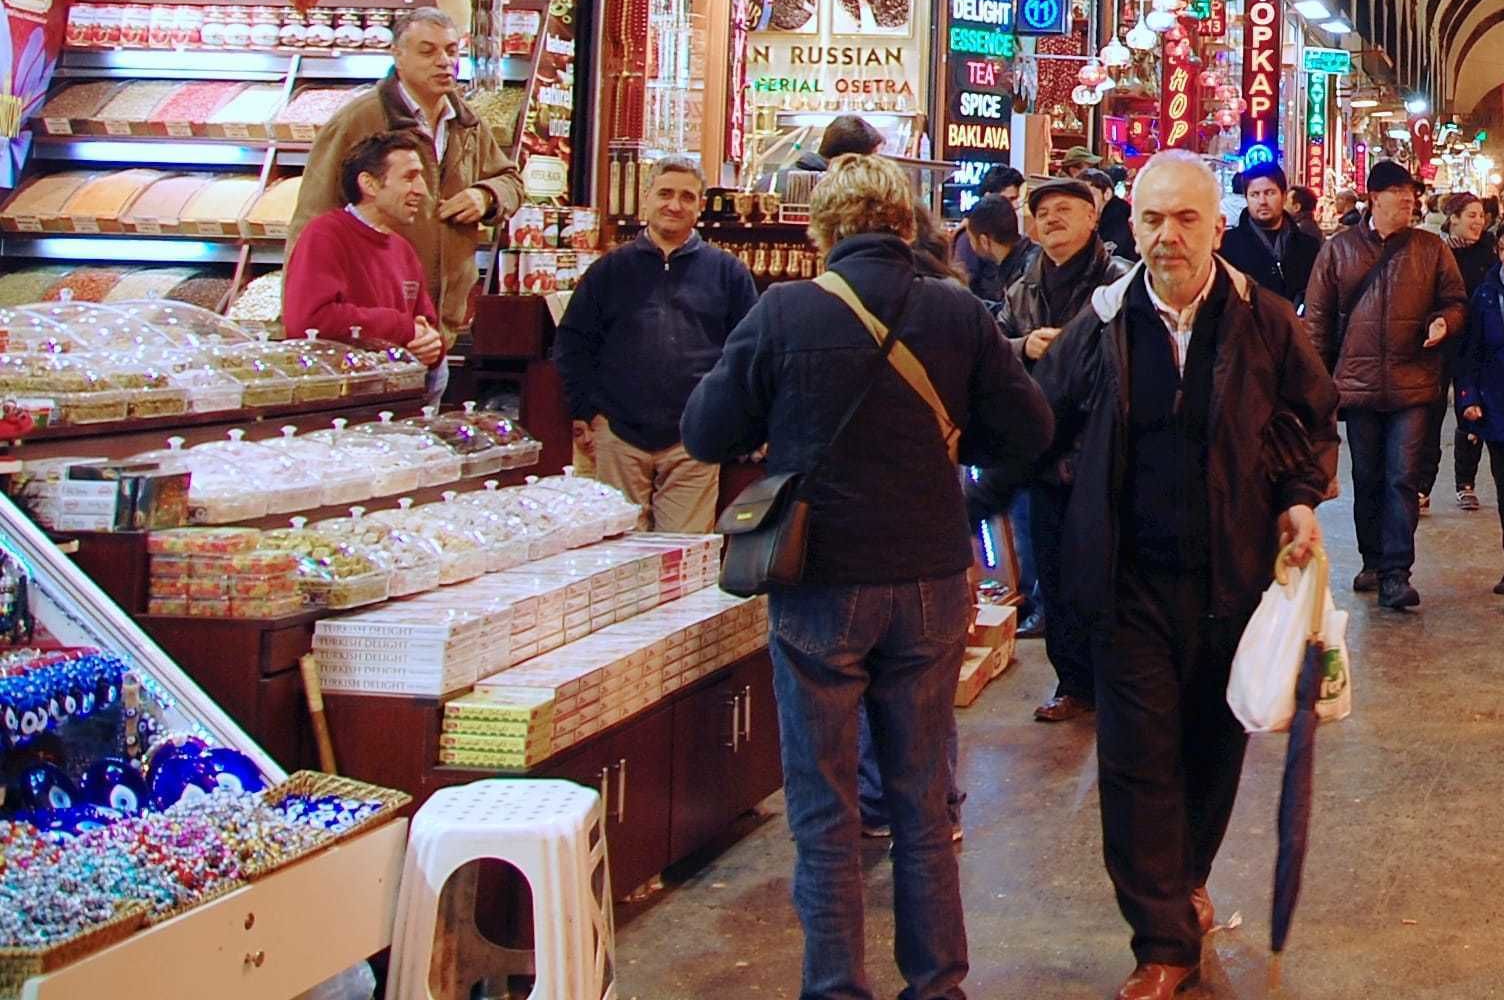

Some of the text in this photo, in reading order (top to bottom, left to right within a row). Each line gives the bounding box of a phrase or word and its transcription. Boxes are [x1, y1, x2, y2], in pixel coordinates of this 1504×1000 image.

[951, 27, 1015, 57] ESSENCE
[790, 45, 904, 67] RUSSIAN
[967, 61, 995, 86] TEA
[835, 77, 913, 97] OSETRA
[1166, 54, 1188, 146] HOP
[960, 92, 1002, 118] SPICE
[948, 123, 1010, 150] BAKLAVA
